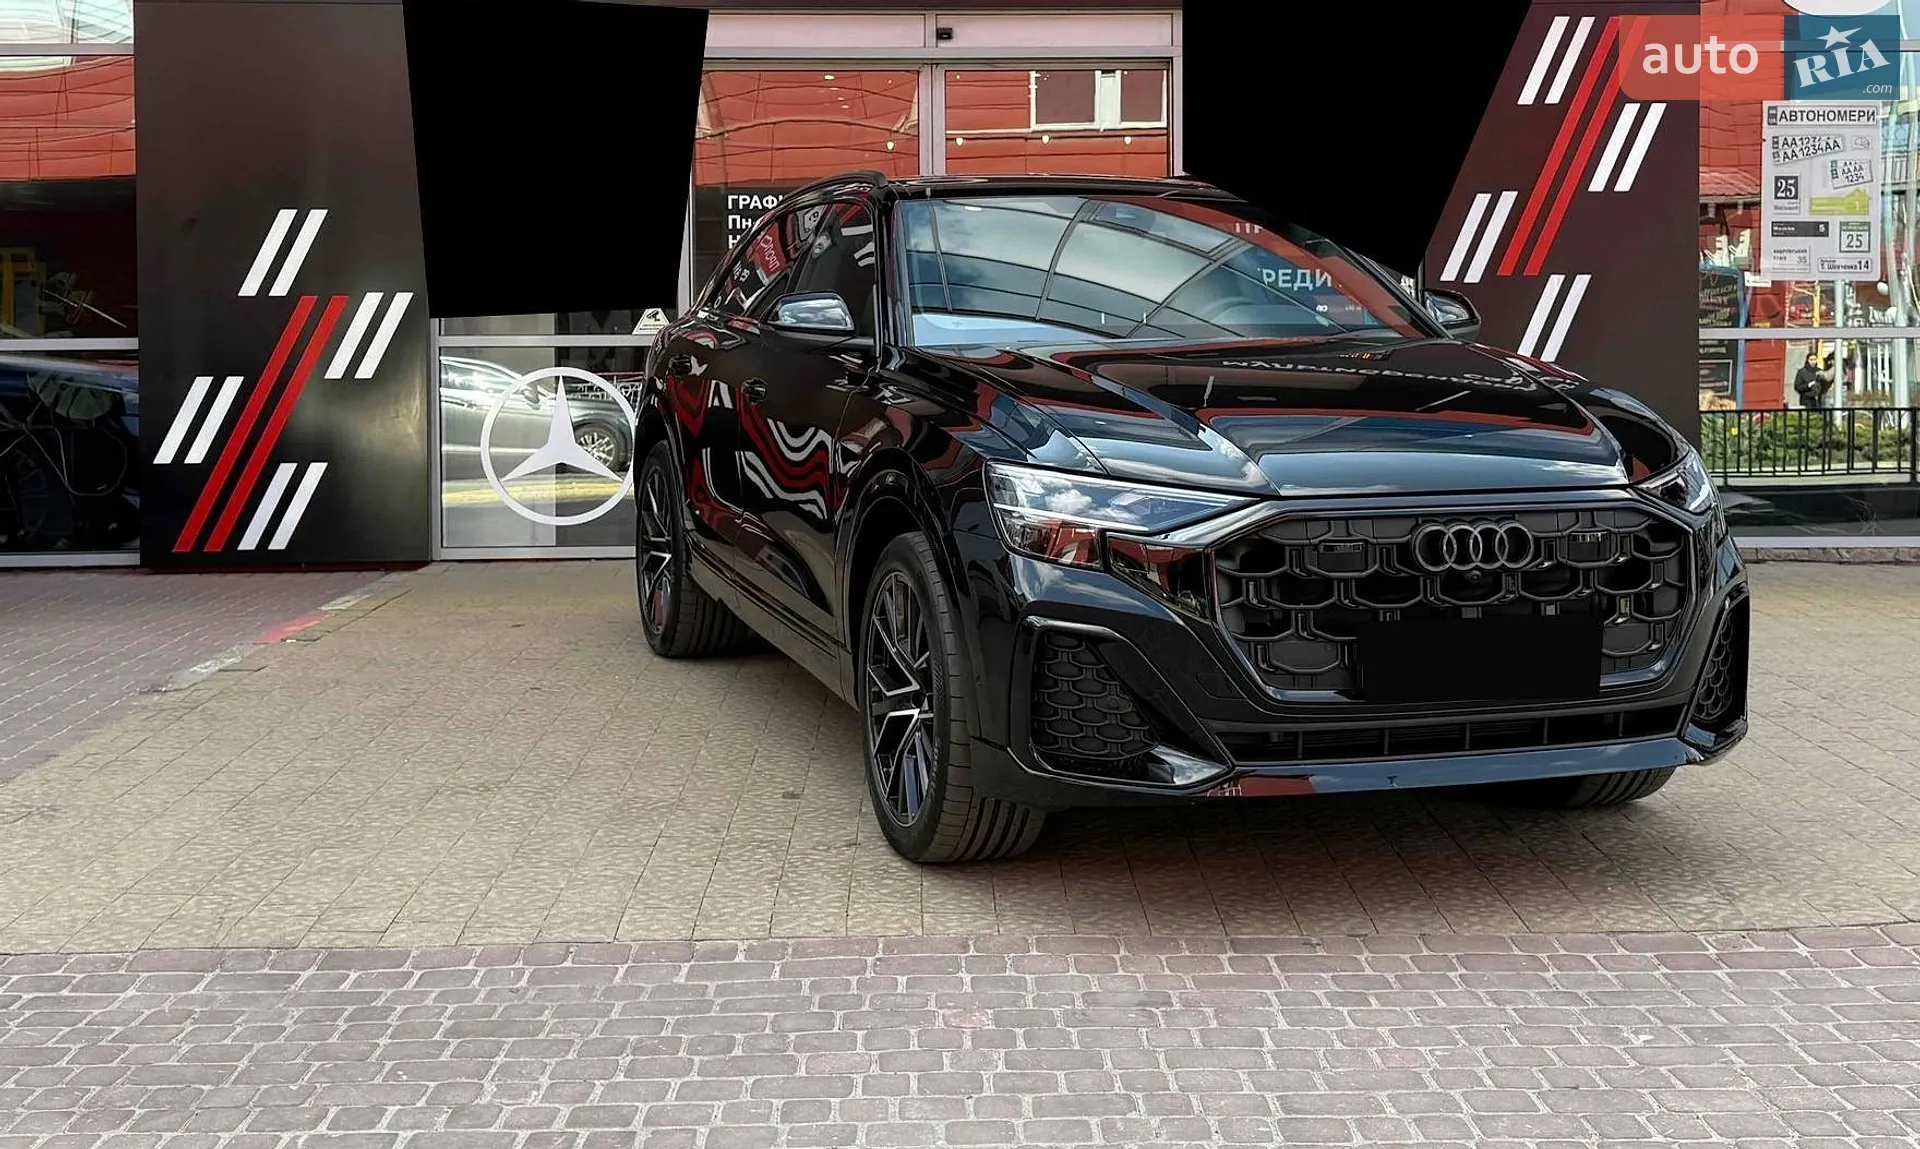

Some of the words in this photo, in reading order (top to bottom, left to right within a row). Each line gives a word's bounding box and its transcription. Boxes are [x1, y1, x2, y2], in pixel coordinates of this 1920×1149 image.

[1779, 110, 1876, 122] АВТОНОМЕРИ
[1776, 179, 1796, 198] 25
[1846, 234, 1864, 249] 25
[1257, 267, 1342, 291] РЕДИ
